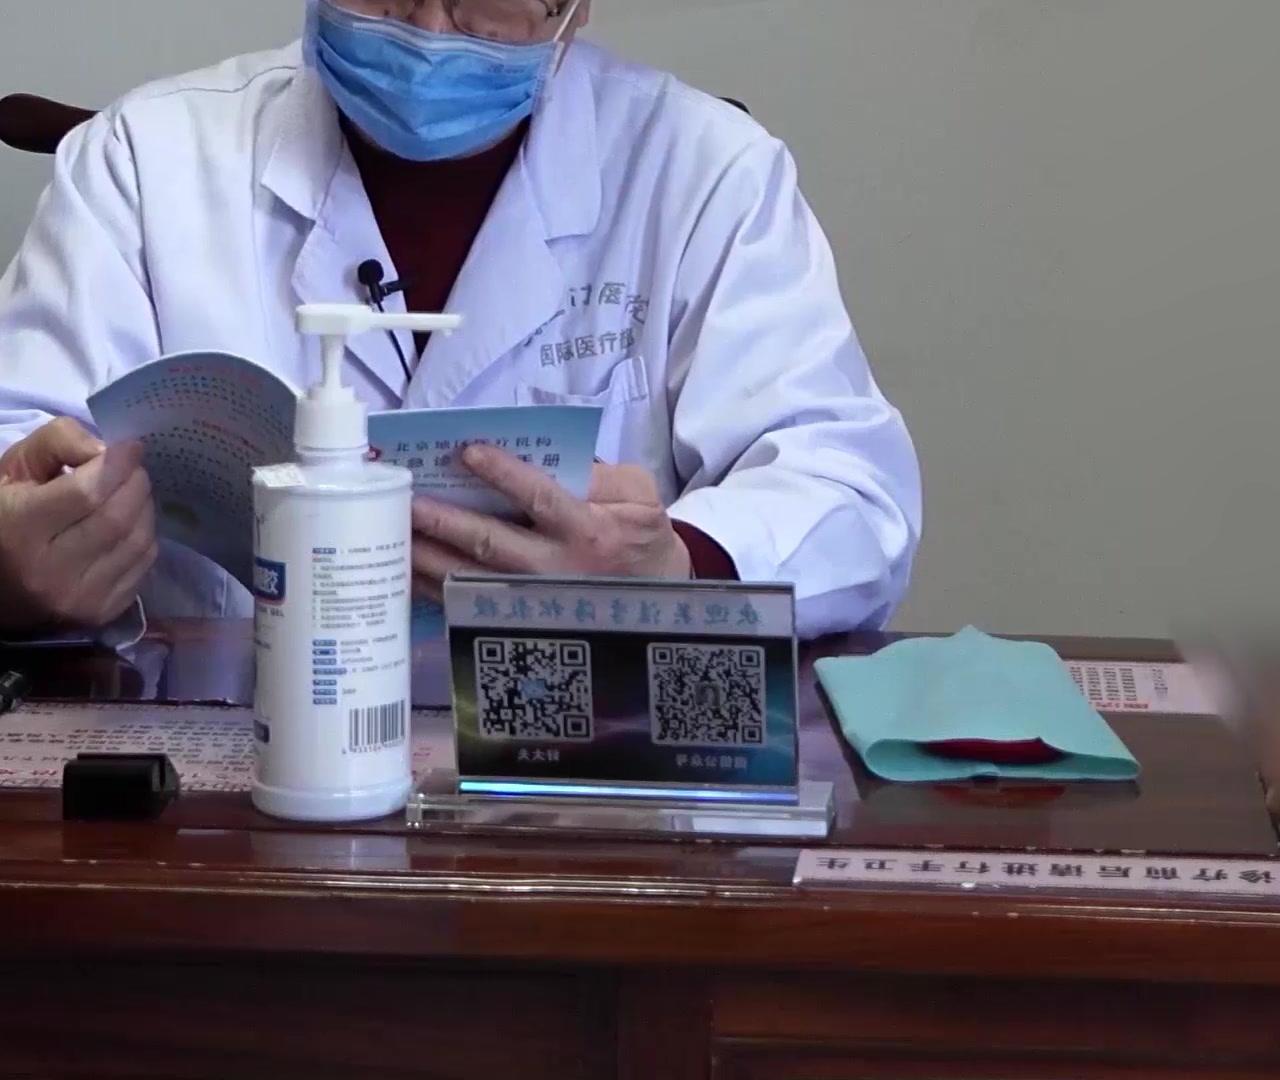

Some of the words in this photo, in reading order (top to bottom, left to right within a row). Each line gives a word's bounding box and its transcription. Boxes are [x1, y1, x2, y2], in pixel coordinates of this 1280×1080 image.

[815, 856, 1277, 886] 诊疗前后请进行手卫生
